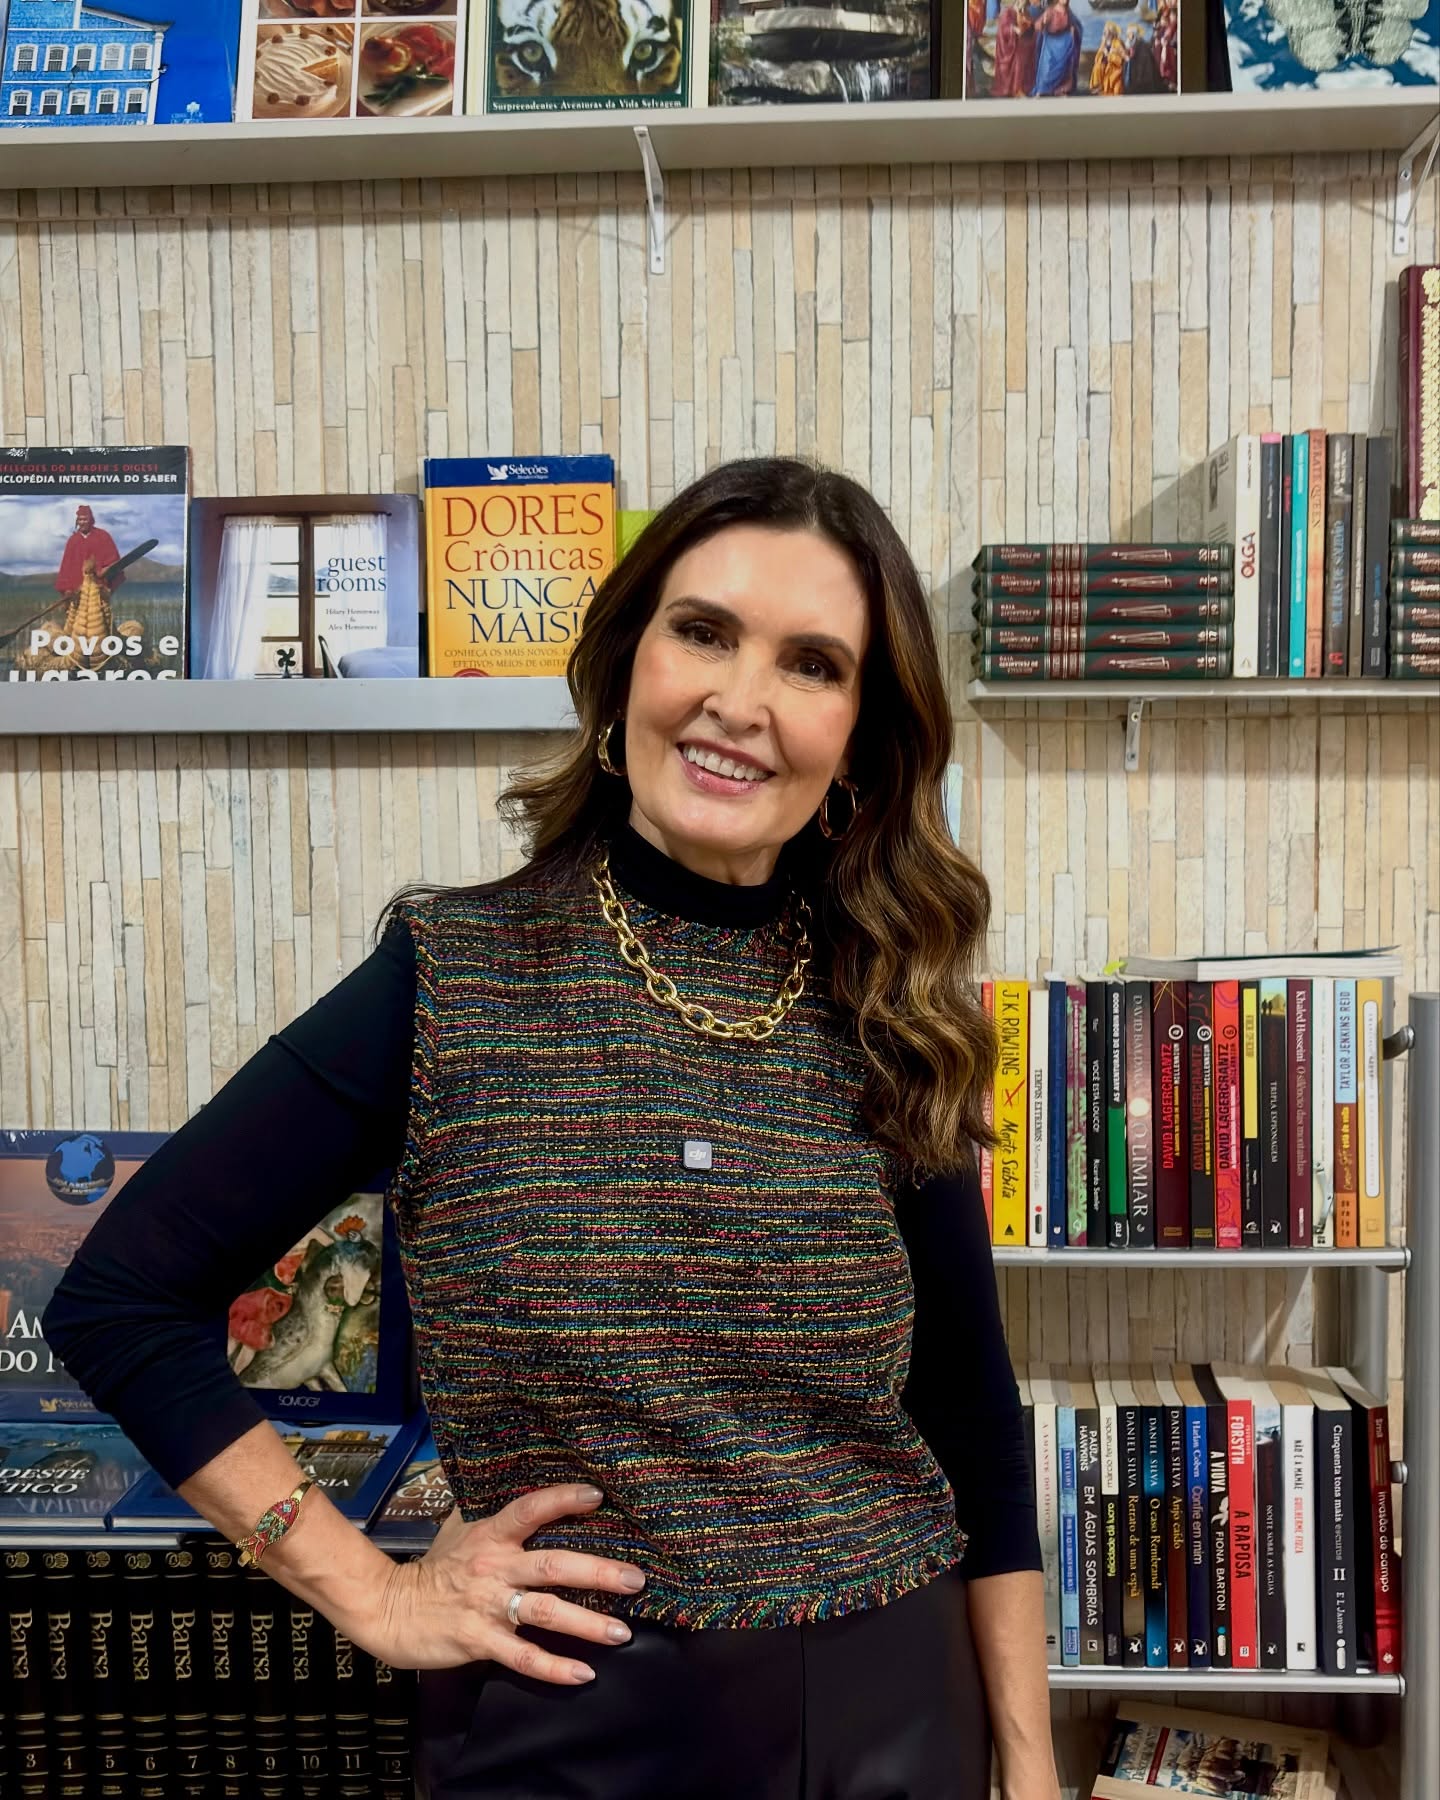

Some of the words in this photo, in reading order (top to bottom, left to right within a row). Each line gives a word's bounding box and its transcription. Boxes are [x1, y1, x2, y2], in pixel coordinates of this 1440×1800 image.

[560, 100, 602, 110] Aventuras
[606, 100, 616, 109] da
[619, 99, 638, 108] Vida
[642, 98, 682, 109] Selvagem
[58, 474, 120, 484] INTERATIVA
[124, 474, 140, 483] DO
[143, 474, 178, 483] SABER
[508, 464, 549, 476] Seleções
[442, 494, 604, 537] DORES
[328, 555, 386, 578] guest
[444, 540, 603, 572] Crônicas
[1240, 532, 1256, 578] OLGA
[316, 577, 386, 592] rooms
[444, 576, 599, 610] NUNCA
[30, 630, 143, 656] Povos
[159, 635, 180, 656] e
[468, 612, 580, 644] MAIS!
[453, 660, 494, 668] EFETIVOS
[496, 660, 523, 668] MEIOS
[490, 649, 502, 657] OS
[504, 648, 525, 656] MAIS
[1133, 994, 1143, 1032] DAVID
[1296, 990, 1306, 1022] Khaled
[1340, 991, 1350, 1012] REID
[1113, 1038, 1119, 1048] DE
[1296, 1024, 1306, 1062] Hosseini
[1340, 1016, 1350, 1054] JENKINS
[1161, 1043, 1173, 1129] LAGERCRANTZ
[1192, 1044, 1203, 1130] LAGERCRANTZ
[1218, 1043, 1229, 1130] LAGERCRANTZ
[1340, 1057, 1351, 1089] TAYLOR
[1114, 1093, 1120, 1102] AS
[1132, 1122, 1148, 1138] O
[1296, 1109, 1306, 1126] das
[1000, 1118, 1019, 1154] Morte
[1162, 1132, 1174, 1169] DAVID
[1219, 1133, 1230, 1169] DAVID
[1270, 1111, 1278, 1162] ESPIONAGEM
[1192, 1134, 1204, 1170] DAVID
[1002, 1159, 1018, 1199] Súbita
[1093, 1159, 1101, 1186] Ricardo
[1132, 1144, 1148, 1217] LIMIAR
[0, 1350, 38, 1372] DO
[278, 1396, 321, 1408] SOMOGY
[1126, 1411, 1135, 1454] DANIEL
[1148, 1417, 1158, 1455] DANIEL
[1170, 1410, 1180, 1452] DANIEL
[1192, 1420, 1201, 1448] Harlan
[1230, 1415, 1245, 1465] FORSYTH
[1294, 1440, 1304, 1452] NÃO
[1080, 1425, 1088, 1472] HAWKINS
[1090, 1430, 1098, 1464] PAULA
[1331, 1424, 1343, 1475] Cinquenta
[1105, 1459, 1113, 1488] márcio
[1127, 1457, 1136, 1488] SILVA
[1150, 1459, 1158, 1486] SILVA
[1172, 1456, 1181, 1488] SILVA
[1193, 1449, 1202, 1477] Coben
[1210, 1461, 1227, 1494] VIÚVA
[1294, 1467, 1304, 1490] MAMÃE
[1084, 1486, 1095, 1504] EM
[1192, 1486, 1204, 1519] Confie
[1334, 1476, 1342, 1498] tons
[1106, 1502, 1115, 1523] lucro
[1128, 1495, 1139, 1532] Retrato
[1150, 1497, 1161, 1509] O
[1170, 1495, 1183, 1520] Anjo
[1234, 1510, 1250, 1519] A
[1334, 1499, 1343, 1522] mais
[1378, 1491, 1389, 1533] invasão
[1085, 1510, 1098, 1556] ÁGUAS
[1106, 1525, 1115, 1536] dá
[1150, 1510, 1158, 1532] caso
[1172, 1522, 1184, 1549] caído
[1192, 1521, 1202, 1538] em
[1130, 1534, 1140, 1546] de
[1193, 1540, 1204, 1564] mim
[1216, 1531, 1225, 1564] FIONA
[1235, 1524, 1251, 1579] RAPOSA
[1335, 1524, 1343, 1561] escuros
[1380, 1535, 1389, 1550] de
[1107, 1537, 1116, 1577] felicidade
[1151, 1535, 1162, 1589] Rembrandt
[1267, 1558, 1274, 1568] AS
[1380, 1552, 1390, 1592] campo
[1216, 1567, 1226, 1611] BARTON
[1334, 1568, 1346, 1581] II
[1086, 1560, 1098, 1626] SOMBRIAS
[1337, 1607, 1345, 1634] James
[10, 1608, 32, 1679] Barsa
[48, 1609, 71, 1680] Barsa
[90, 1609, 112, 1679] Barsa
[130, 1610, 153, 1681] Barsa
[171, 1609, 196, 1681] Barsa
[211, 1609, 234, 1680] Barsa
[251, 1611, 274, 1681] Barsa
[291, 1608, 314, 1681] Barsa
[26, 1753, 36, 1768] 3
[63, 1755, 72, 1770] 4
[105, 1755, 115, 1768] 5
[145, 1756, 155, 1770] 6
[188, 1755, 198, 1768] 7
[226, 1755, 236, 1769] 8
[265, 1756, 275, 1770] 9
[302, 1755, 320, 1770] 10
[344, 1754, 360, 1769] 11
